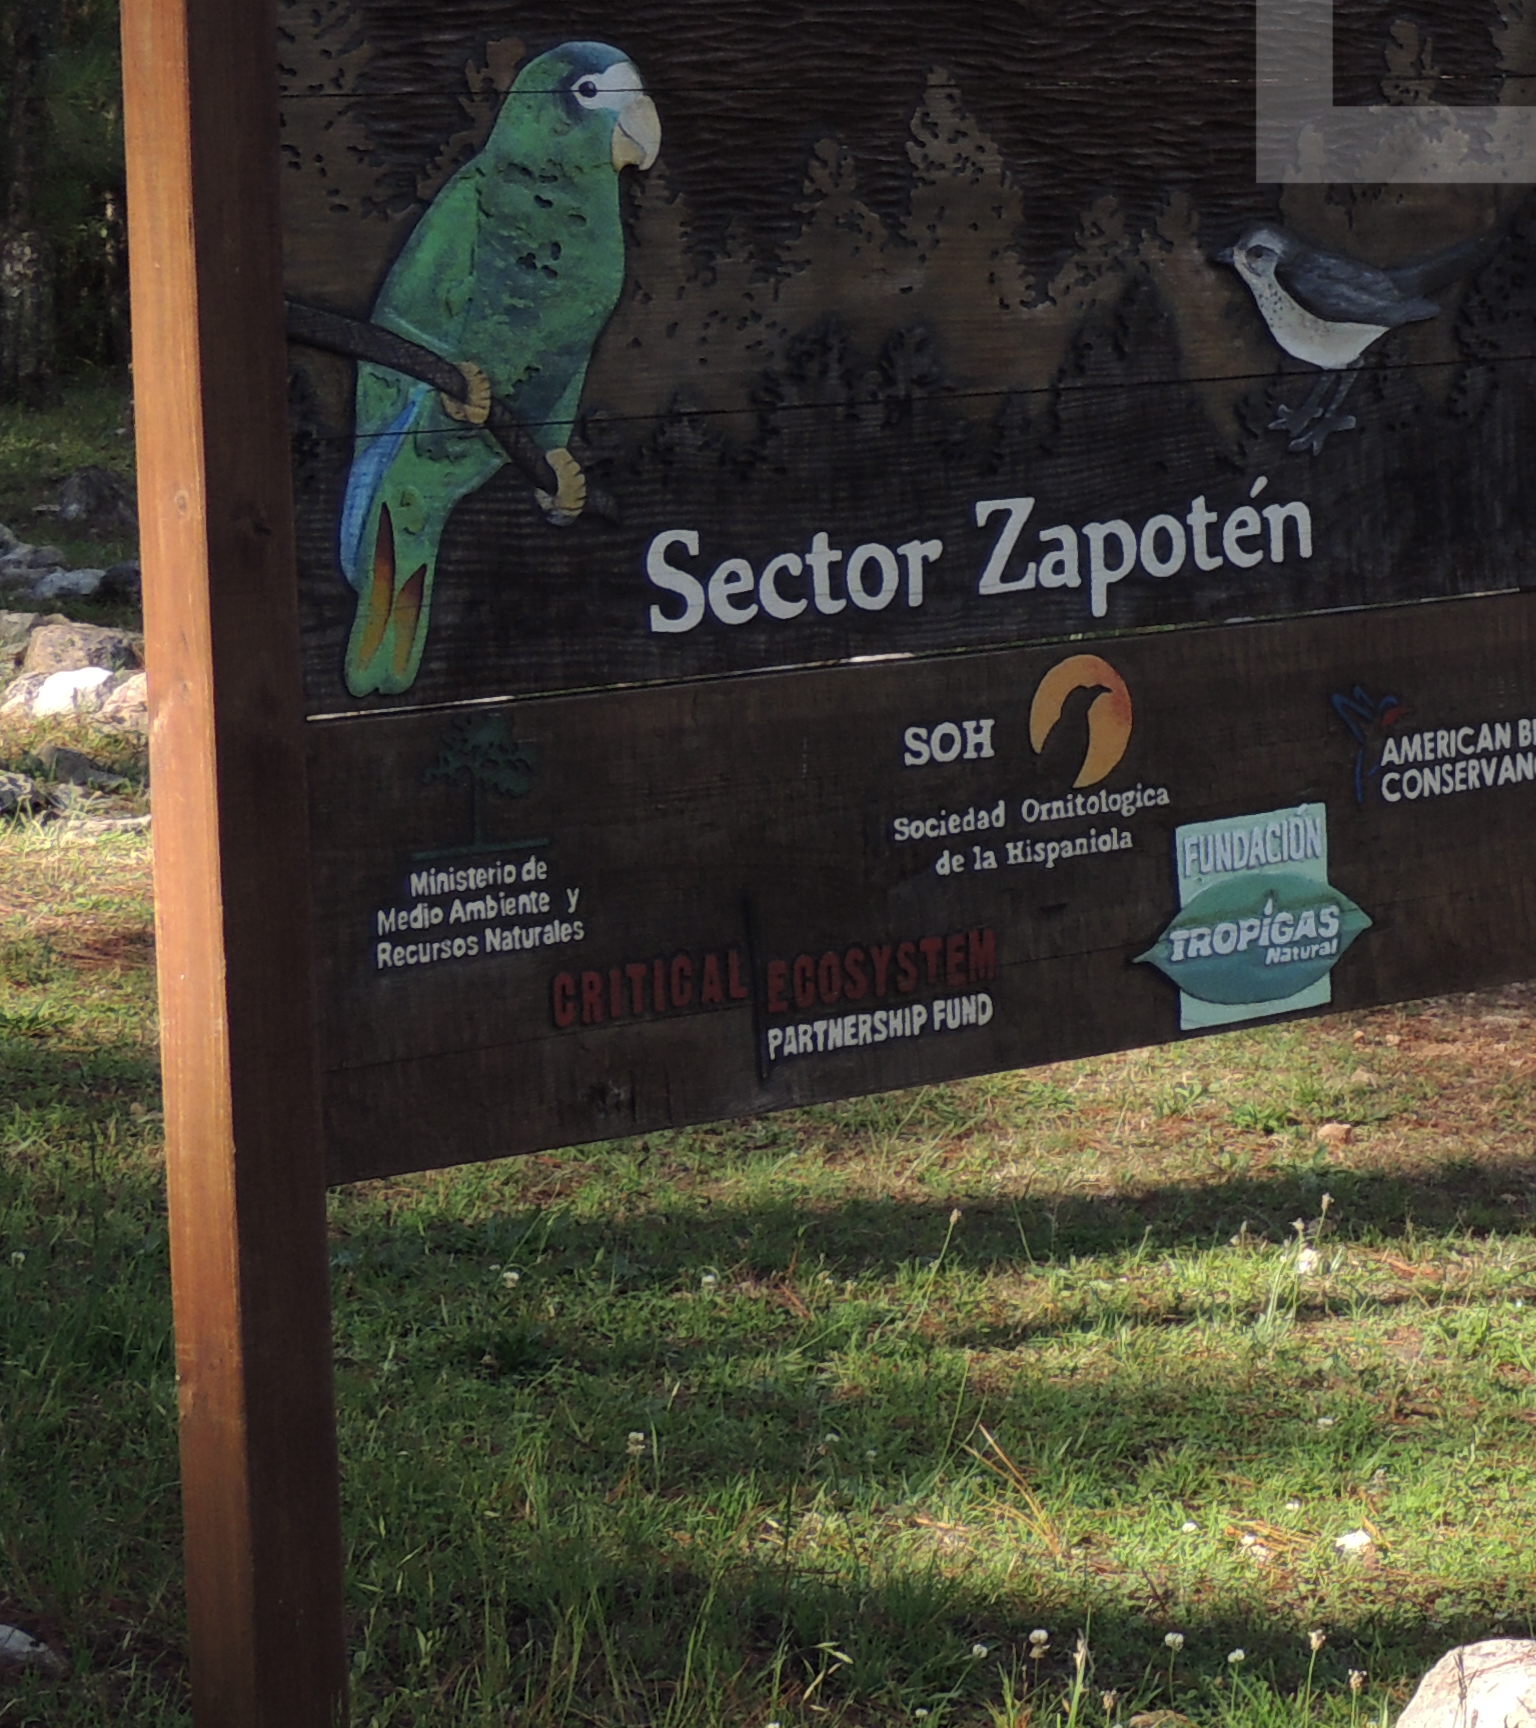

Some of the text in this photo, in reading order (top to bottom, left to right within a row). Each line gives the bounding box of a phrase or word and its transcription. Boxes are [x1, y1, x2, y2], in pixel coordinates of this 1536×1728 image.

[645, 476, 1312, 633] Sector Zapotén
[904, 719, 995, 766] SOH
[1381, 722, 1511, 766] AMERICAN
[894, 783, 1170, 840] Sociedad Ornitologica
[935, 827, 1133, 876] de la Hispaniola
[1183, 803, 1322, 878] FUNDACIÓN
[410, 855, 547, 897] Ministerio de
[377, 887, 580, 936] Medio Ambiente y
[377, 920, 585, 969] Recursos Naturales
[1264, 938, 1338, 966] Natural
[552, 927, 998, 1029] CRITICAL ECOSYSTEM
[767, 992, 993, 1060] PARTNERSHIP FUND
